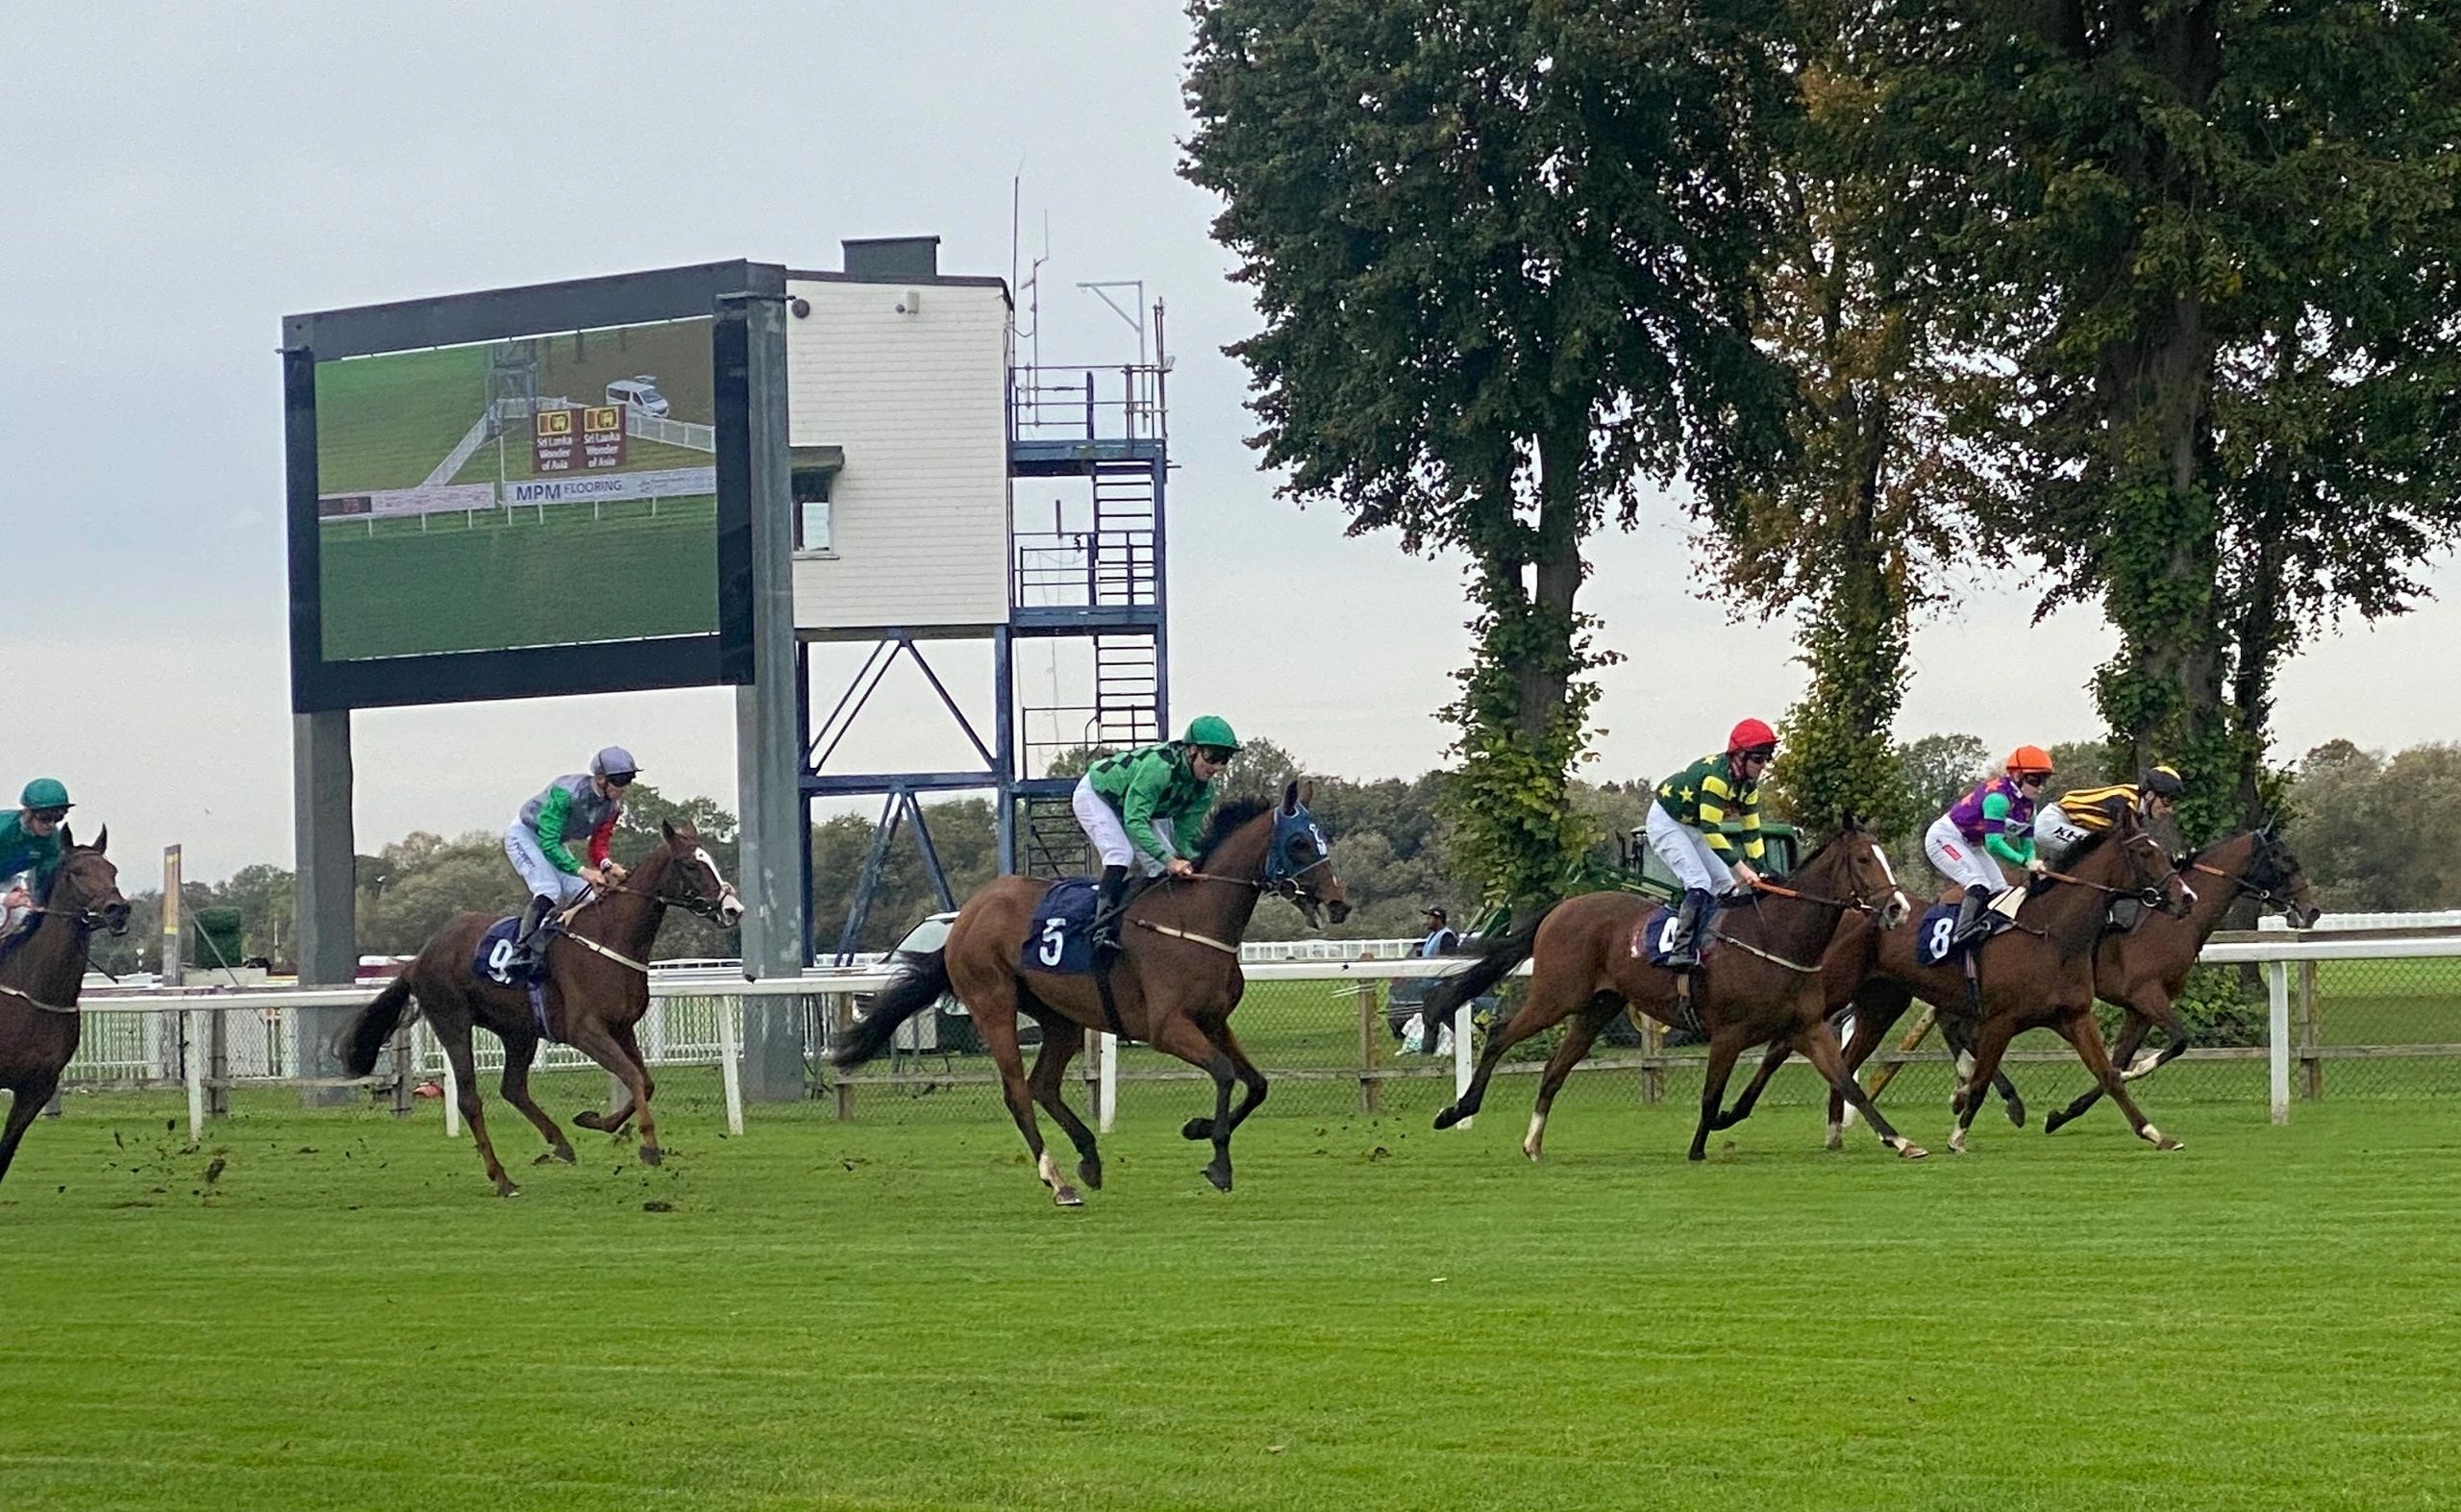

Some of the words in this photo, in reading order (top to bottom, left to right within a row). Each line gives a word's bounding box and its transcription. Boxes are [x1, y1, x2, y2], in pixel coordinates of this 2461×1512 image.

[549, 435, 573, 446] Lanka
[596, 432, 620, 442] Lanka
[516, 484, 560, 501] MPM
[564, 480, 622, 494] FLOORING
[1039, 918, 1066, 966] 5
[1929, 917, 1953, 959] 8
[487, 939, 513, 982] 9
